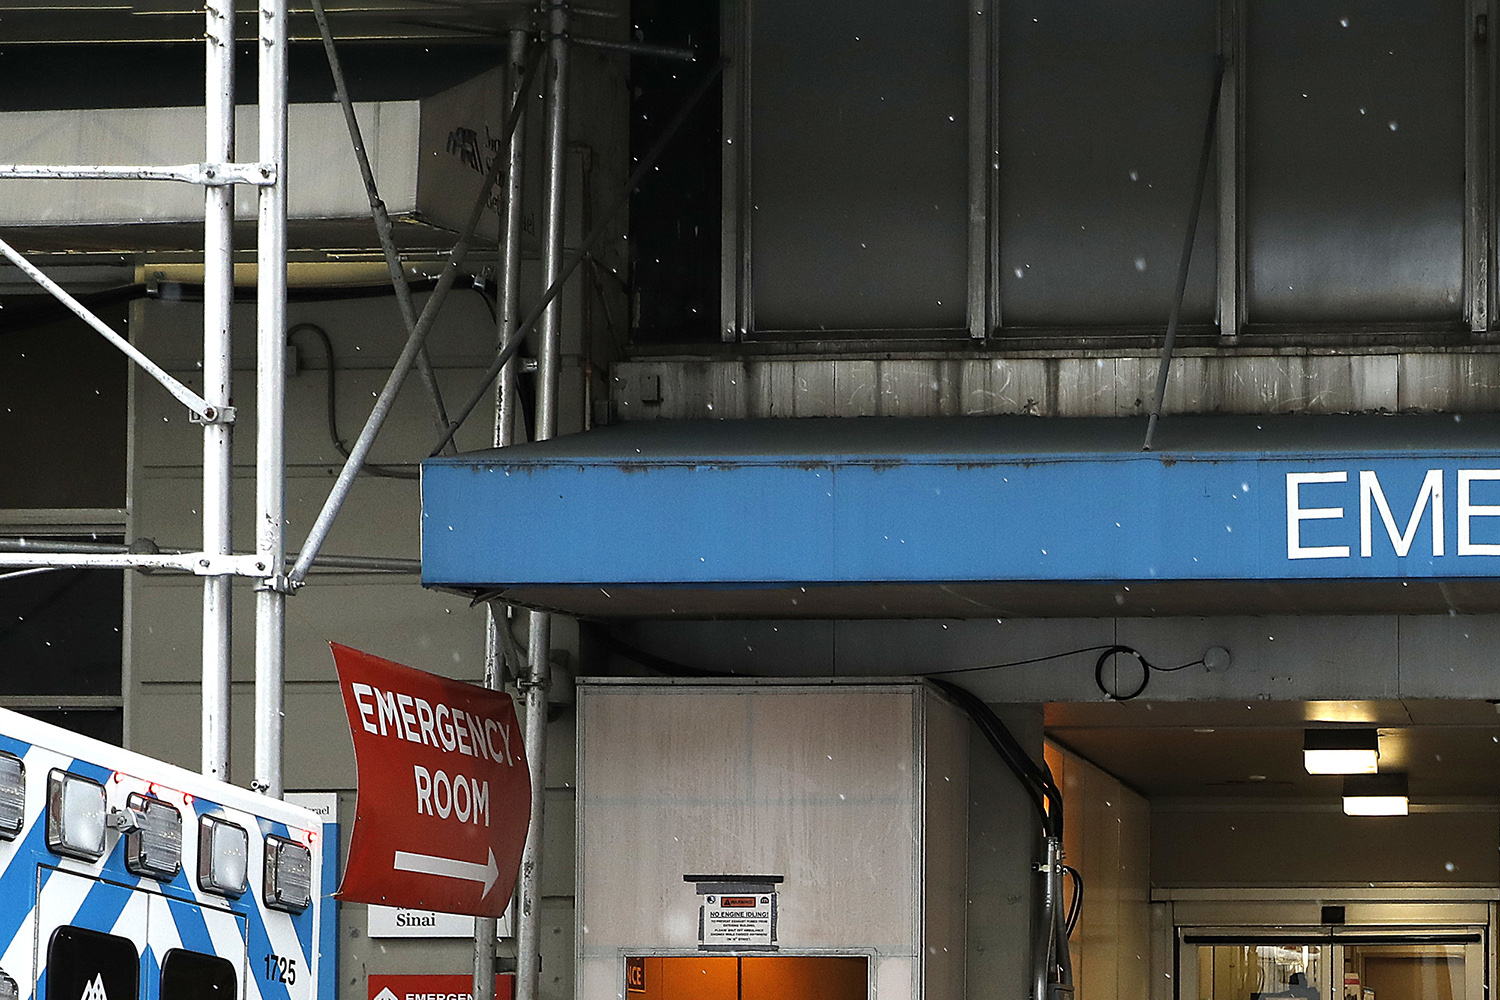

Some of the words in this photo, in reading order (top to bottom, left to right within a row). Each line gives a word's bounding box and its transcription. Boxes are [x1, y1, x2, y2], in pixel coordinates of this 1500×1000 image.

[352, 682, 513, 767] EMERGENCY
[414, 764, 490, 827] ROOM
[396, 913, 436, 927] Sinai
[264, 953, 296, 986] 1725
